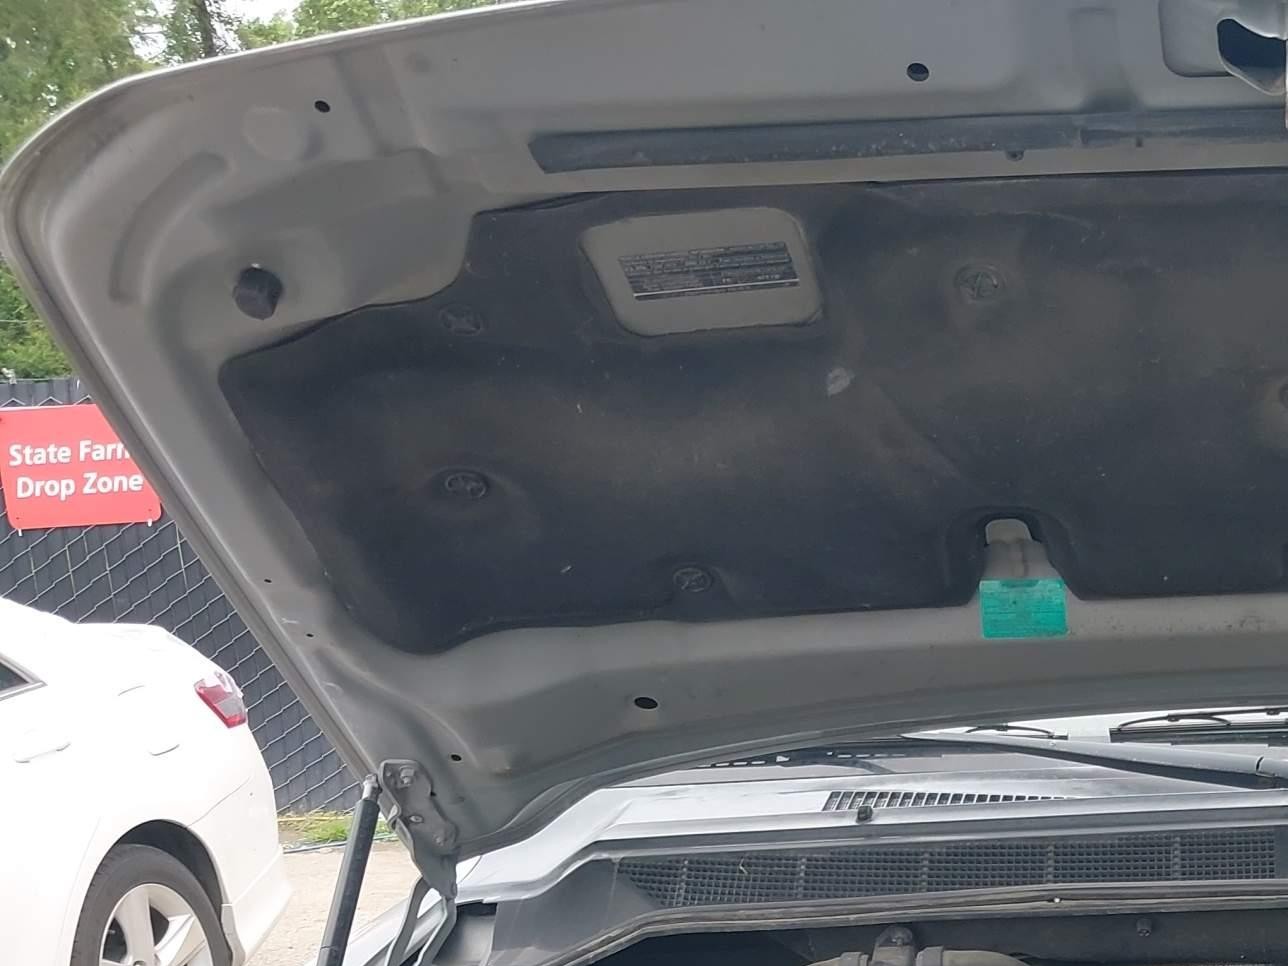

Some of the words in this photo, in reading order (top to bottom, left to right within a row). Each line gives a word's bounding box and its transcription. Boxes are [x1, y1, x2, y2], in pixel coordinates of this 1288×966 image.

[8, 444, 72, 466] State
[16, 476, 75, 501] Drop
[83, 472, 144, 494] Zone
